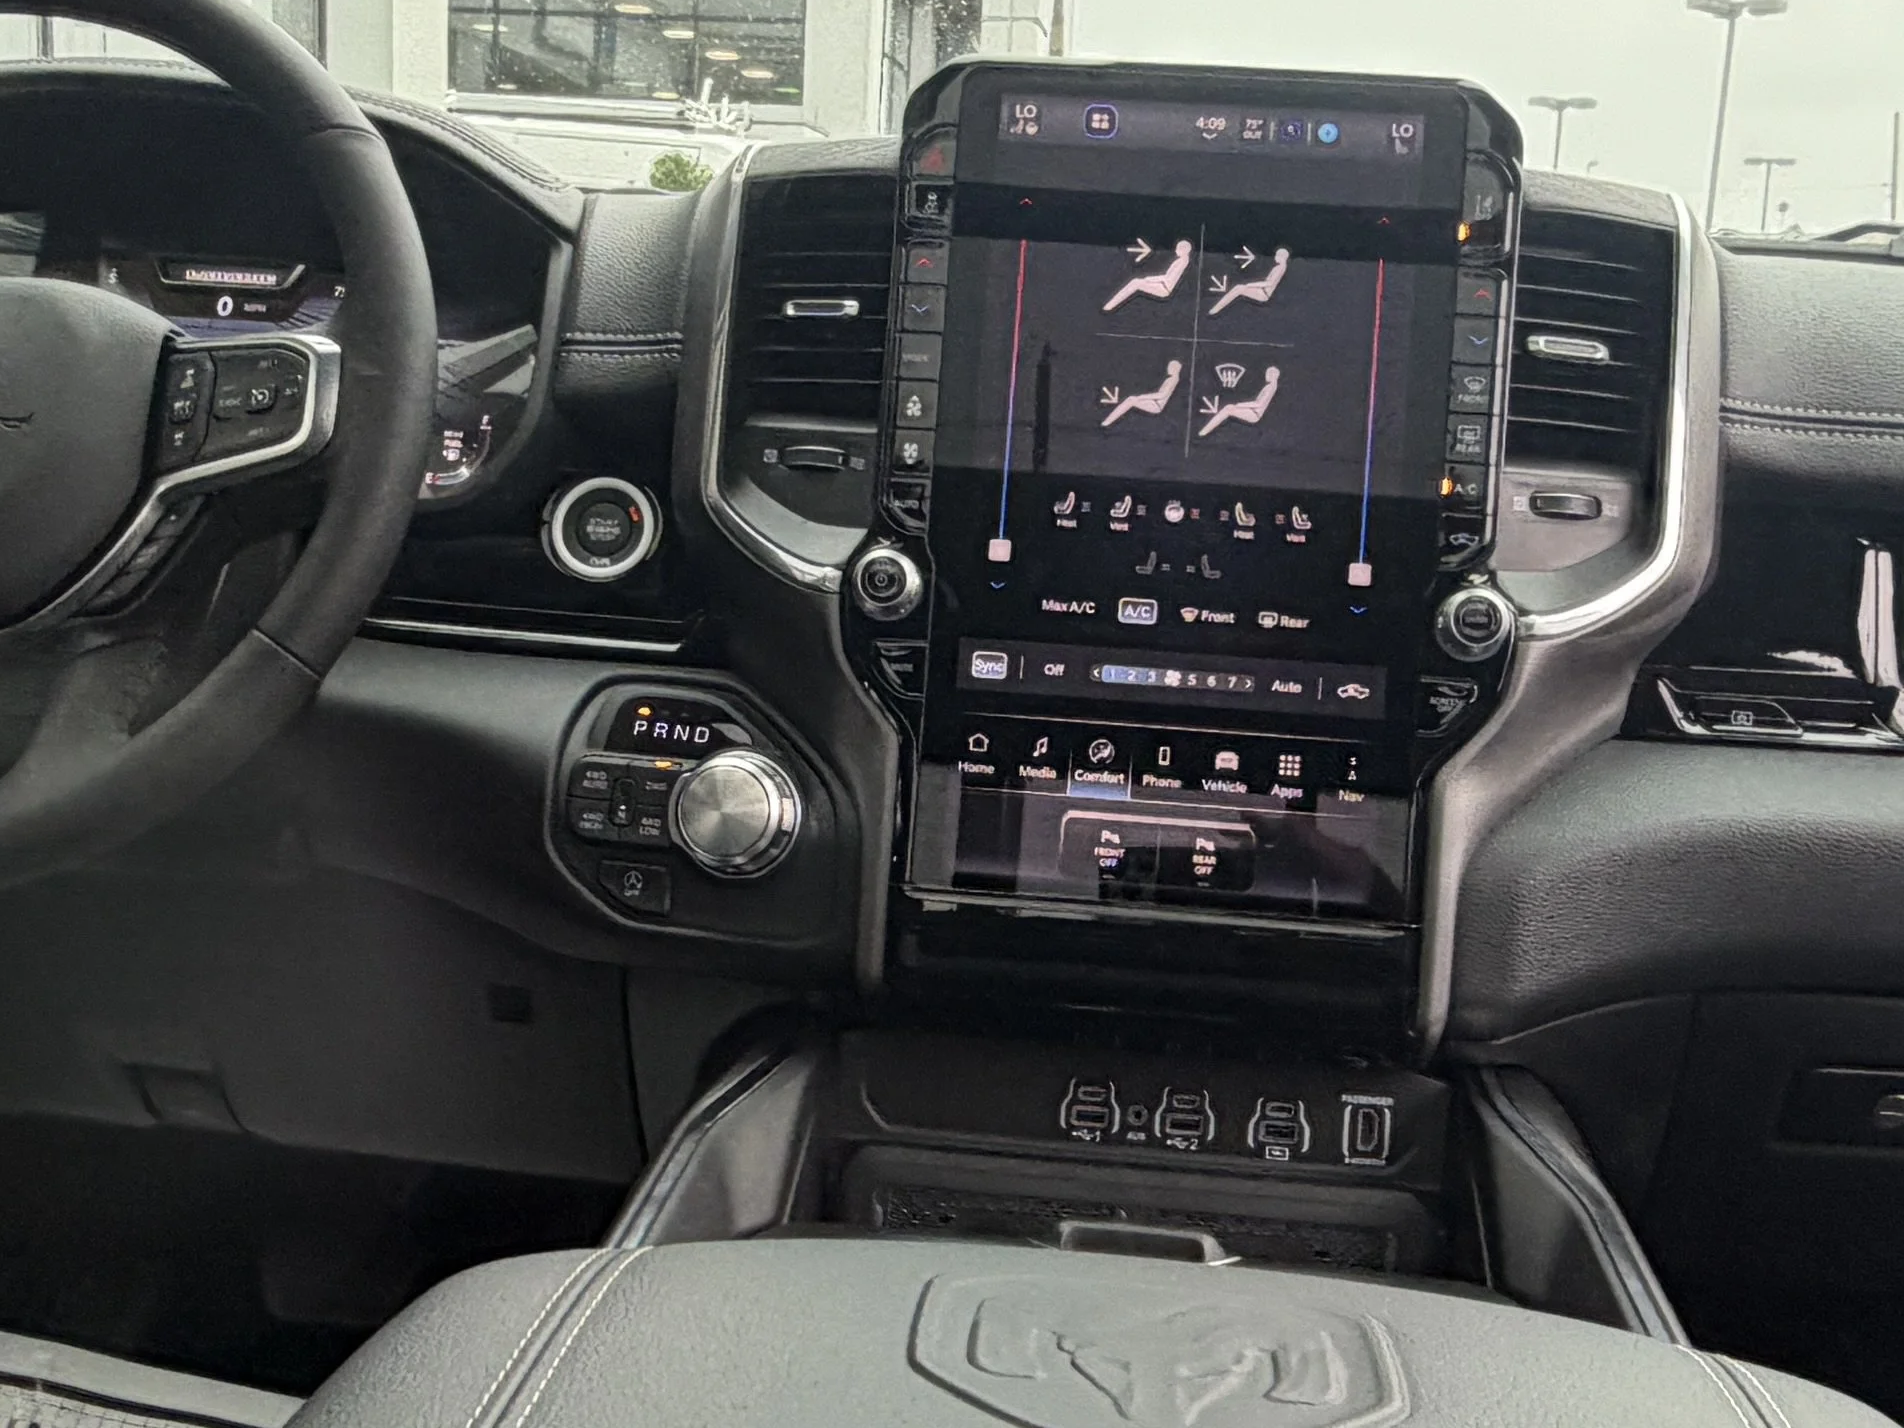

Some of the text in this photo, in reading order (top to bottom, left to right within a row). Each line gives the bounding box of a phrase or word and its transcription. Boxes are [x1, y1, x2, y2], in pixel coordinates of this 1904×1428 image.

[1015, 104, 1038, 119] LO
[1196, 116, 1227, 131] 4:09
[1392, 123, 1414, 138] LO
[217, 295, 234, 317] 0
[1041, 599, 1096, 614] Max A/C
[1124, 606, 1152, 619] A/C
[1201, 610, 1236, 623] Front
[1280, 615, 1310, 628] Rear
[974, 658, 1004, 673] Sync
[1044, 663, 1066, 676] Off
[1187, 674, 1197, 686] 5
[1207, 675, 1217, 688] 6
[1228, 676, 1238, 689] 7
[1271, 679, 1303, 693] Auto
[958, 760, 995, 774] Home
[1019, 764, 1057, 780] Media
[1074, 769, 1124, 784] Comfort
[1142, 774, 1182, 788] Phone
[1201, 778, 1247, 794] Vehicle
[1270, 783, 1304, 799] Apps
[1338, 789, 1365, 803] Nav
